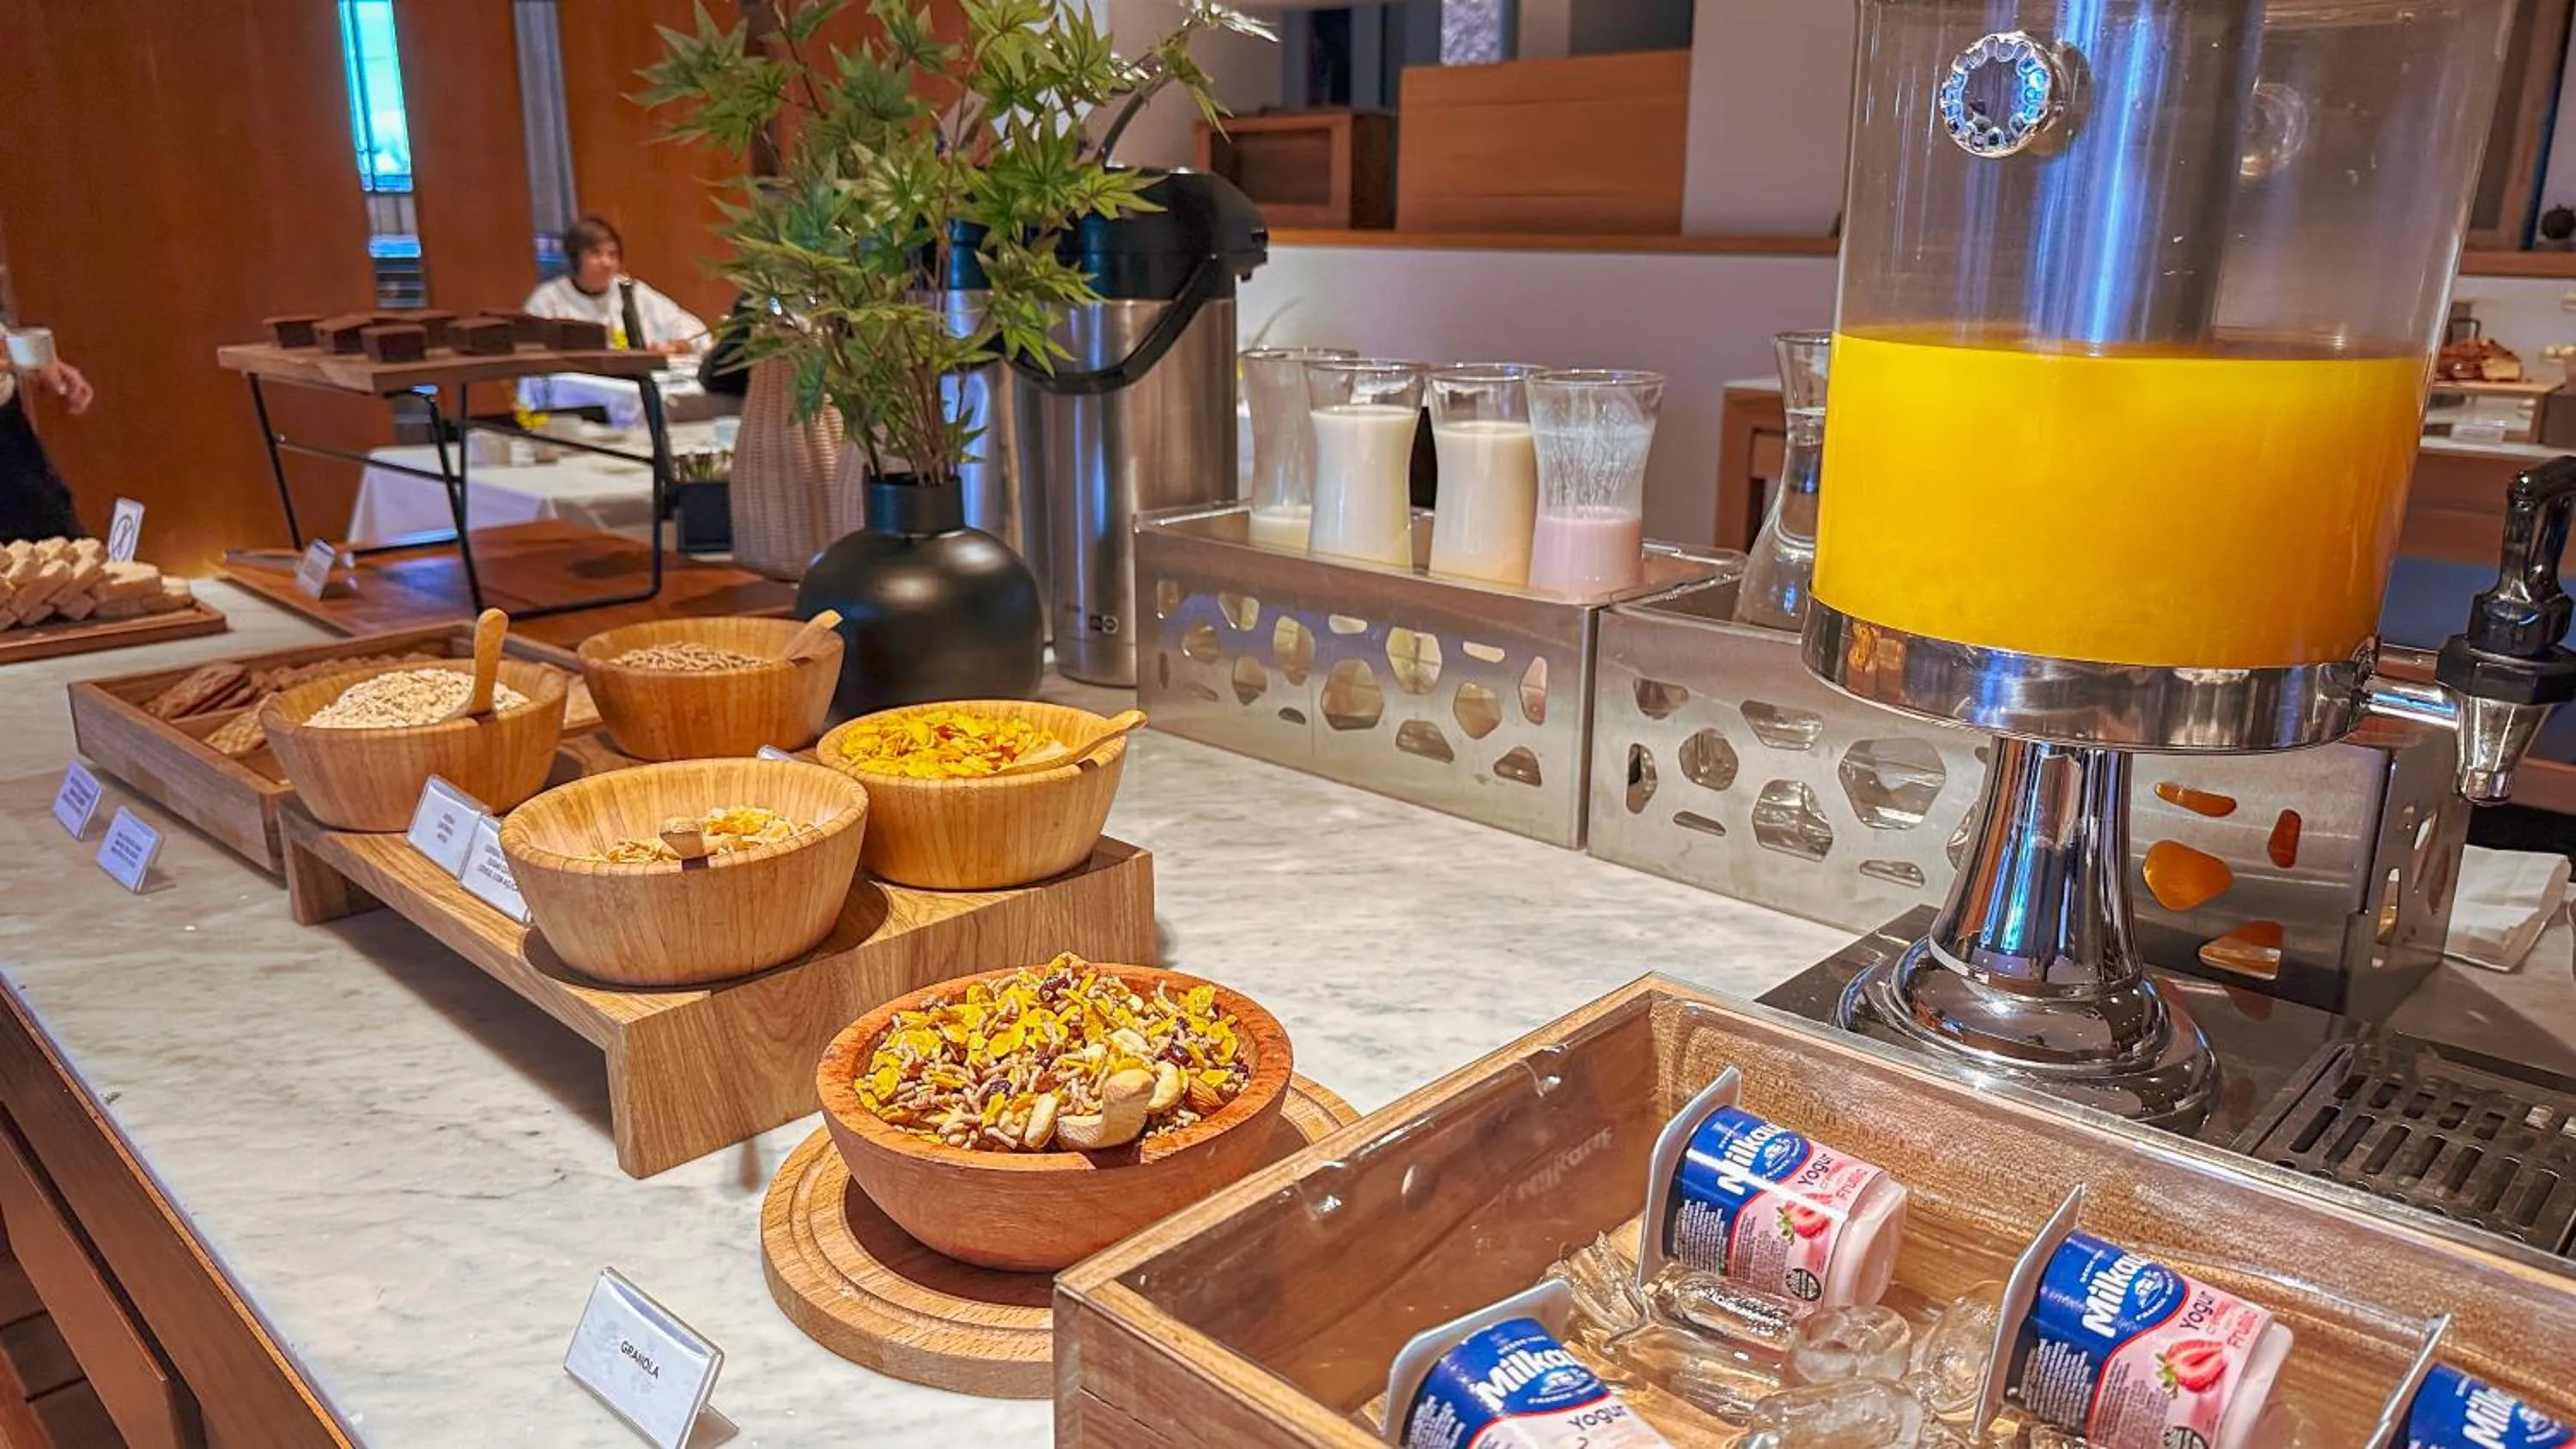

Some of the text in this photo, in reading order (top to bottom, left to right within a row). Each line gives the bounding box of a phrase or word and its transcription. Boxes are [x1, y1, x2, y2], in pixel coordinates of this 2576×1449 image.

[1717, 1120, 1792, 1196] Milkau
[1798, 1154, 1835, 1187] Yogur
[2081, 1250, 2150, 1338] Milkau
[2179, 1290, 2216, 1331] Yogur
[621, 1340, 659, 1379] GRANOLA
[1475, 1349, 1585, 1412] Milka
[1567, 1404, 1627, 1432] Yogur
